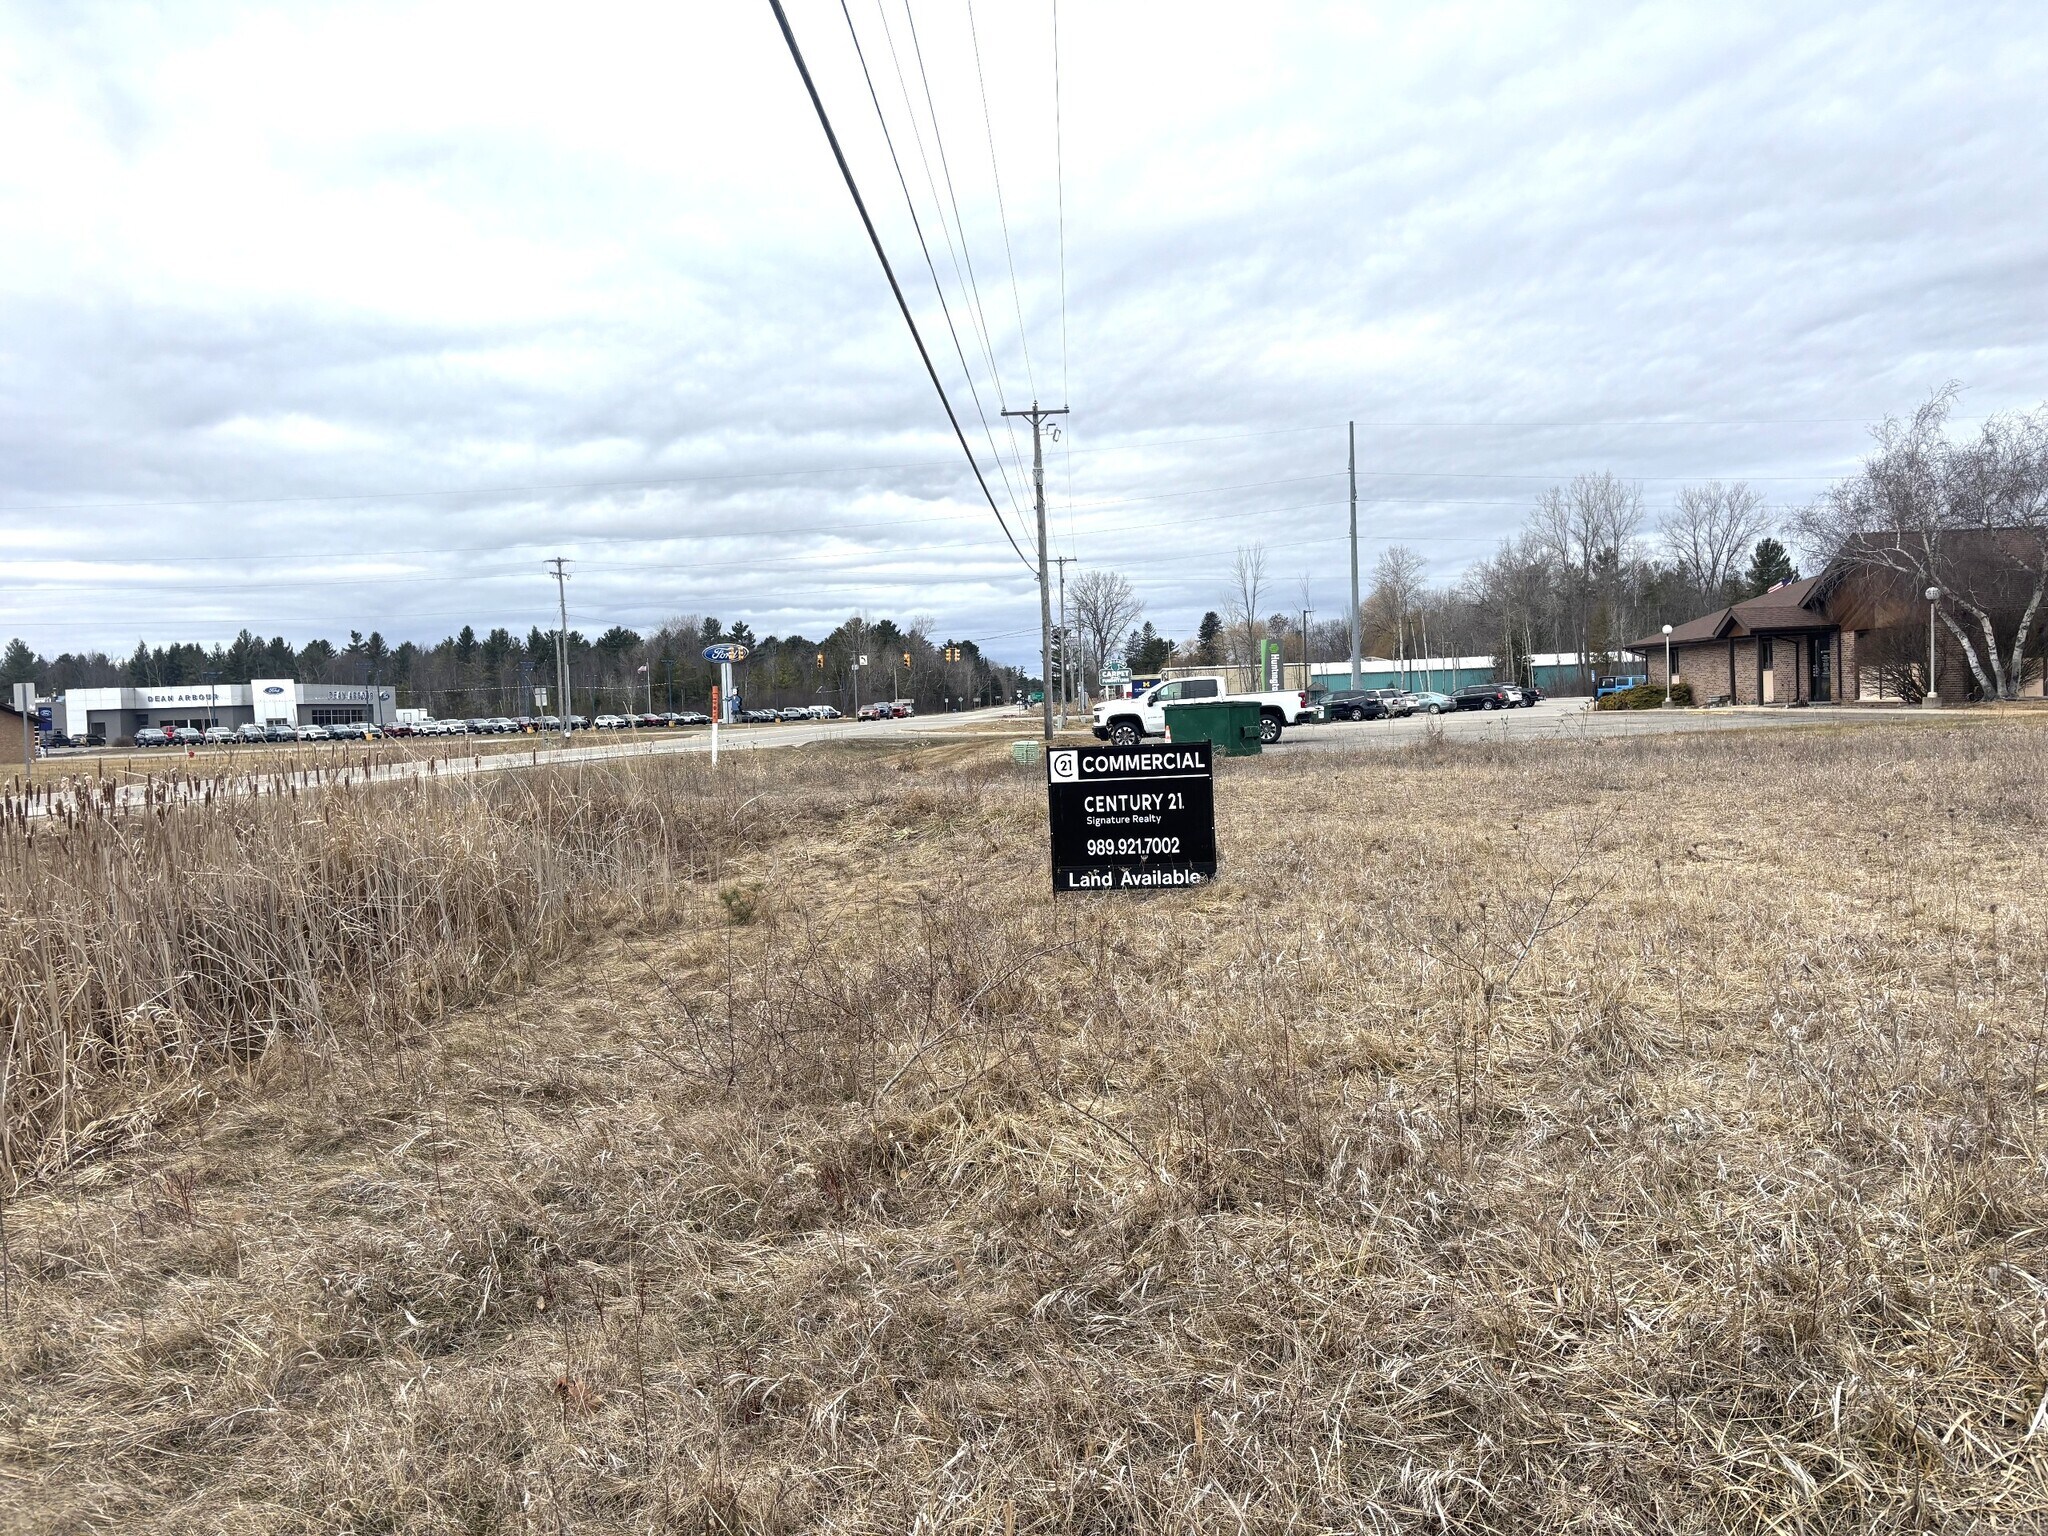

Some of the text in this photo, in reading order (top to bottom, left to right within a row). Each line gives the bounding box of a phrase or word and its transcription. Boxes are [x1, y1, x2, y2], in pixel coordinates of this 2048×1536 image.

[1270, 654, 1279, 691] Huntingto
[178, 694, 219, 702] ARBOUR
[1082, 752, 1205, 773] COMMERCIAL
[1084, 793, 1164, 812] CENTURY
[1086, 814, 1162, 827] Signature Realty
[1087, 837, 1180, 856] 989.921.7002
[1069, 869, 1201, 887] Land Available
